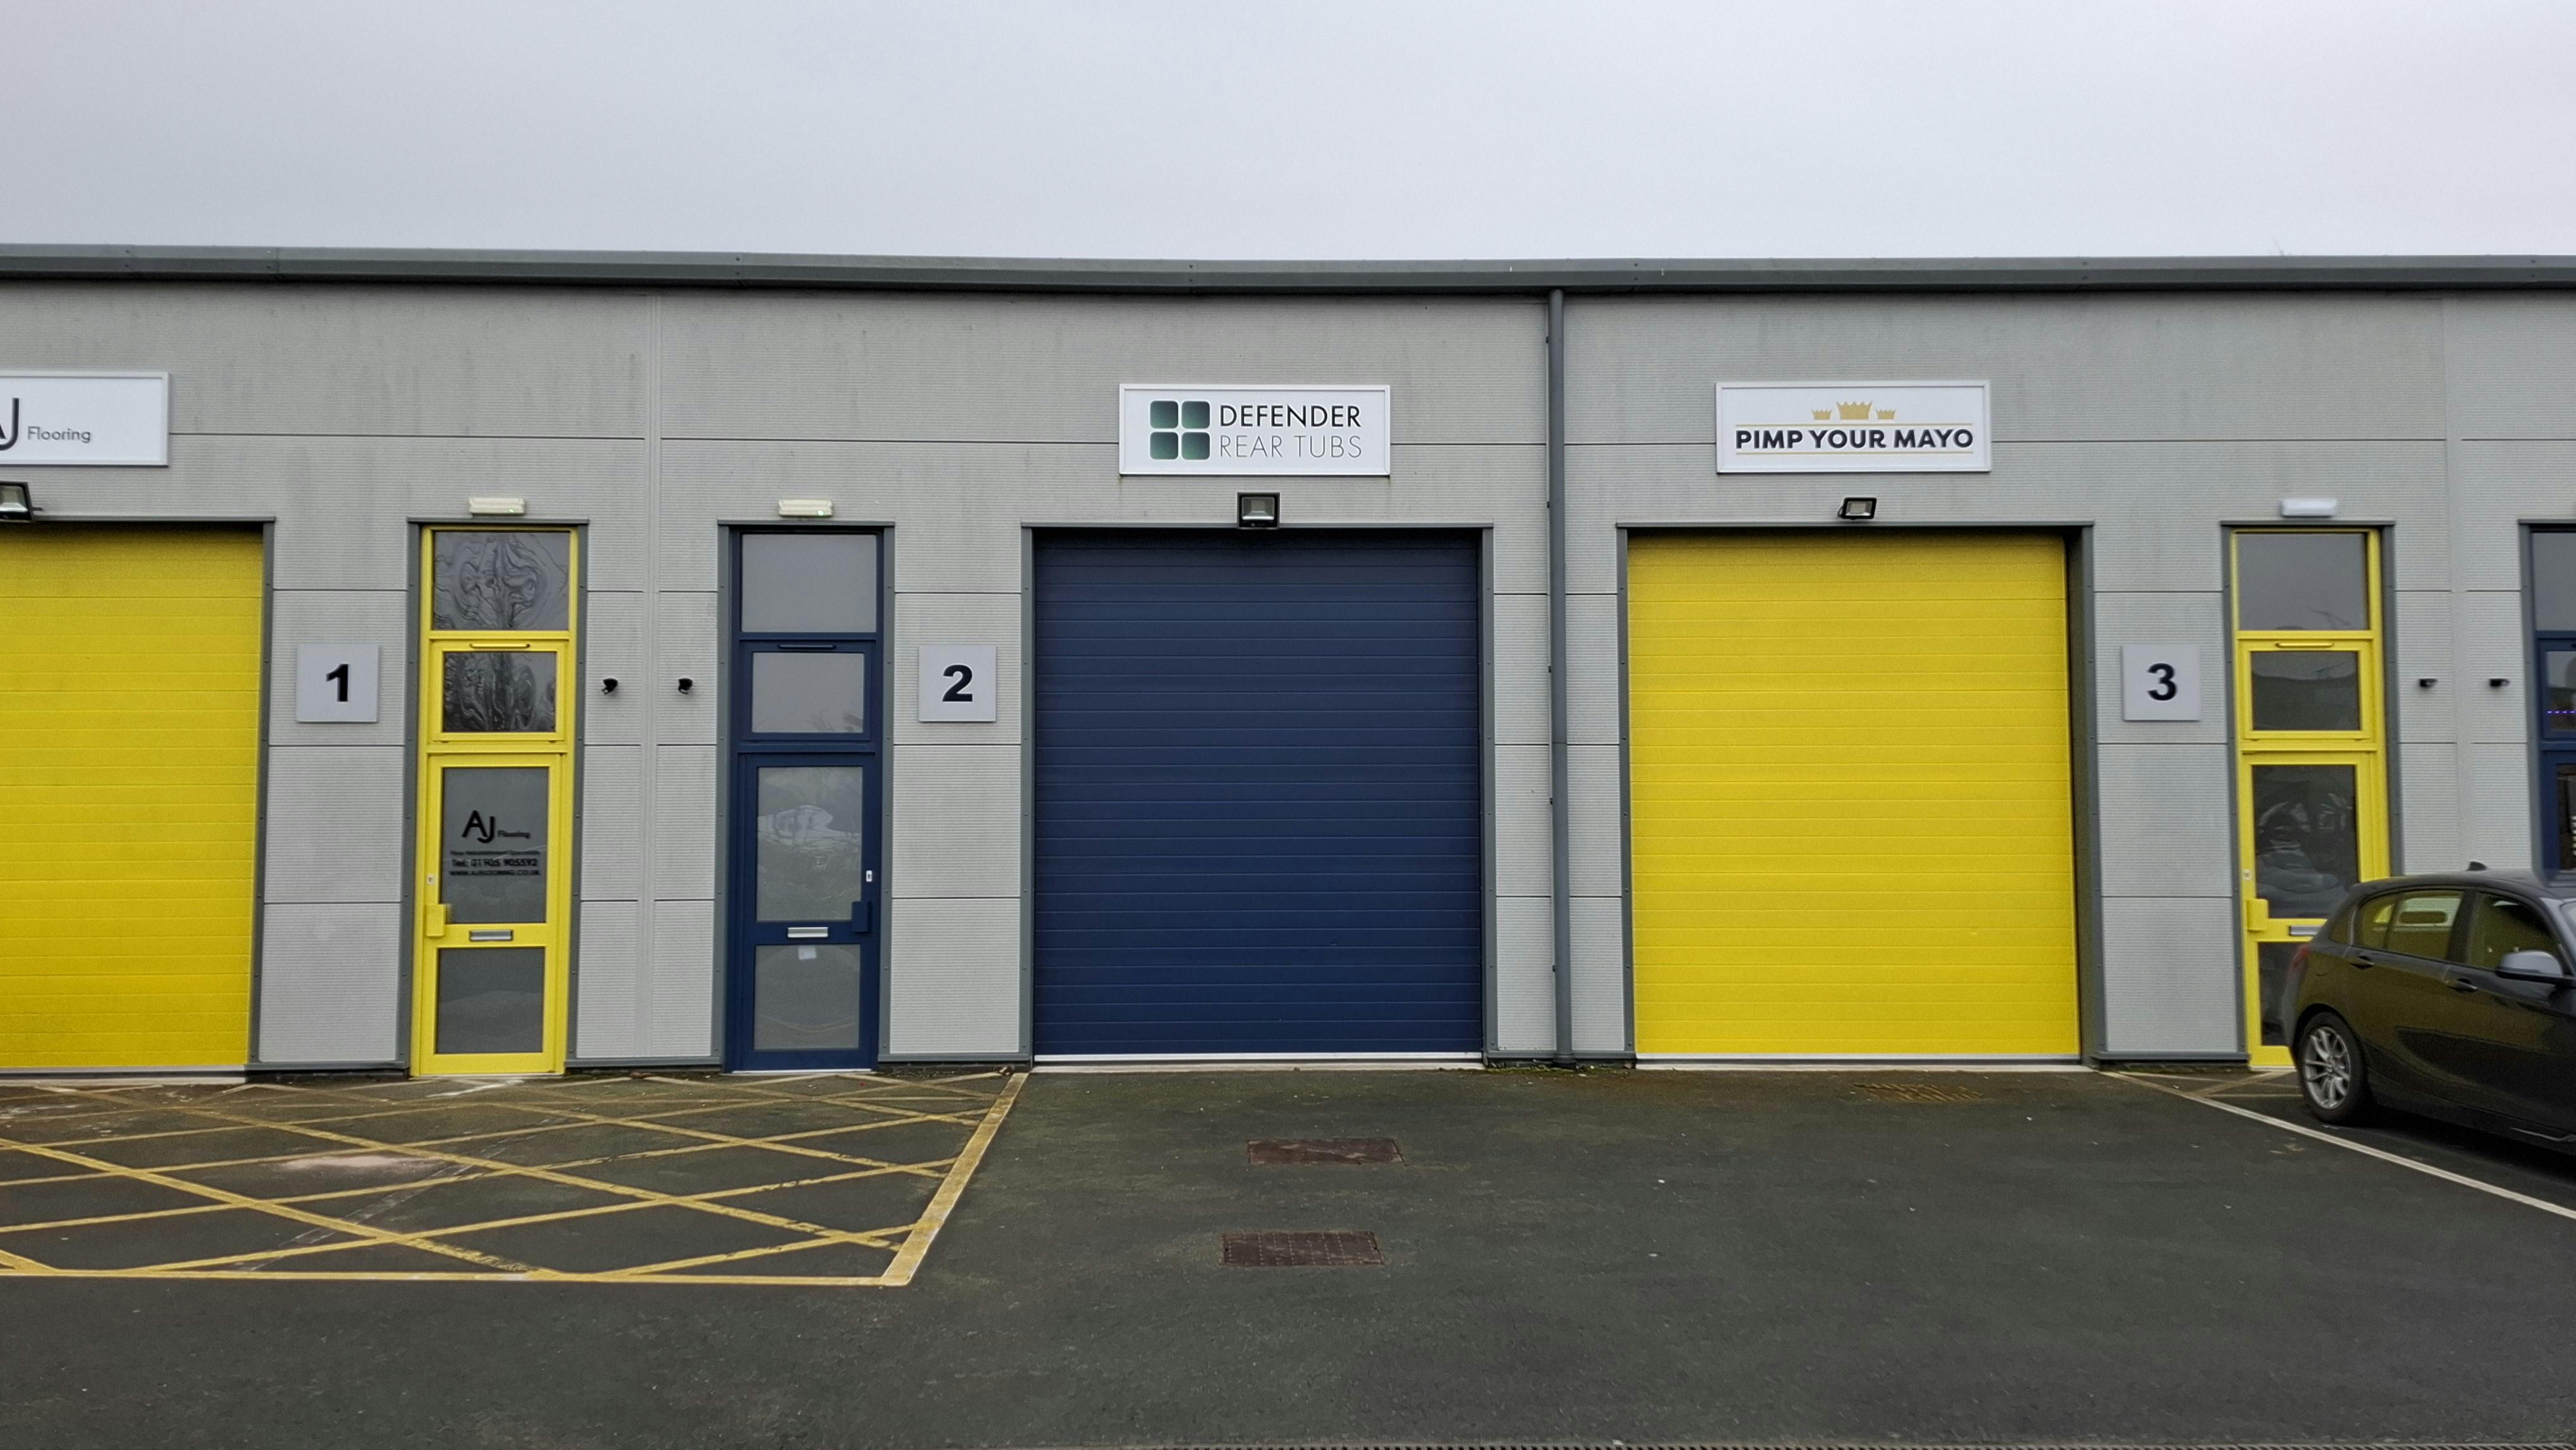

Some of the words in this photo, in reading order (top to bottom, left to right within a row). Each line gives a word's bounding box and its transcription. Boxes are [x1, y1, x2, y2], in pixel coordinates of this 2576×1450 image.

[0, 397, 20, 452] J
[27, 426, 91, 443] Flooring
[1220, 404, 1361, 428] DEFENDER
[1220, 435, 1283, 458] REAR
[1294, 435, 1362, 458] TUBS
[1736, 429, 1803, 449] PIMP
[1808, 429, 1887, 449] YOUR
[1893, 428, 1974, 448] MAYO
[326, 663, 349, 702] 1
[942, 664, 973, 702] 2
[2147, 662, 2178, 701] 3
[461, 810, 495, 844] AJ
